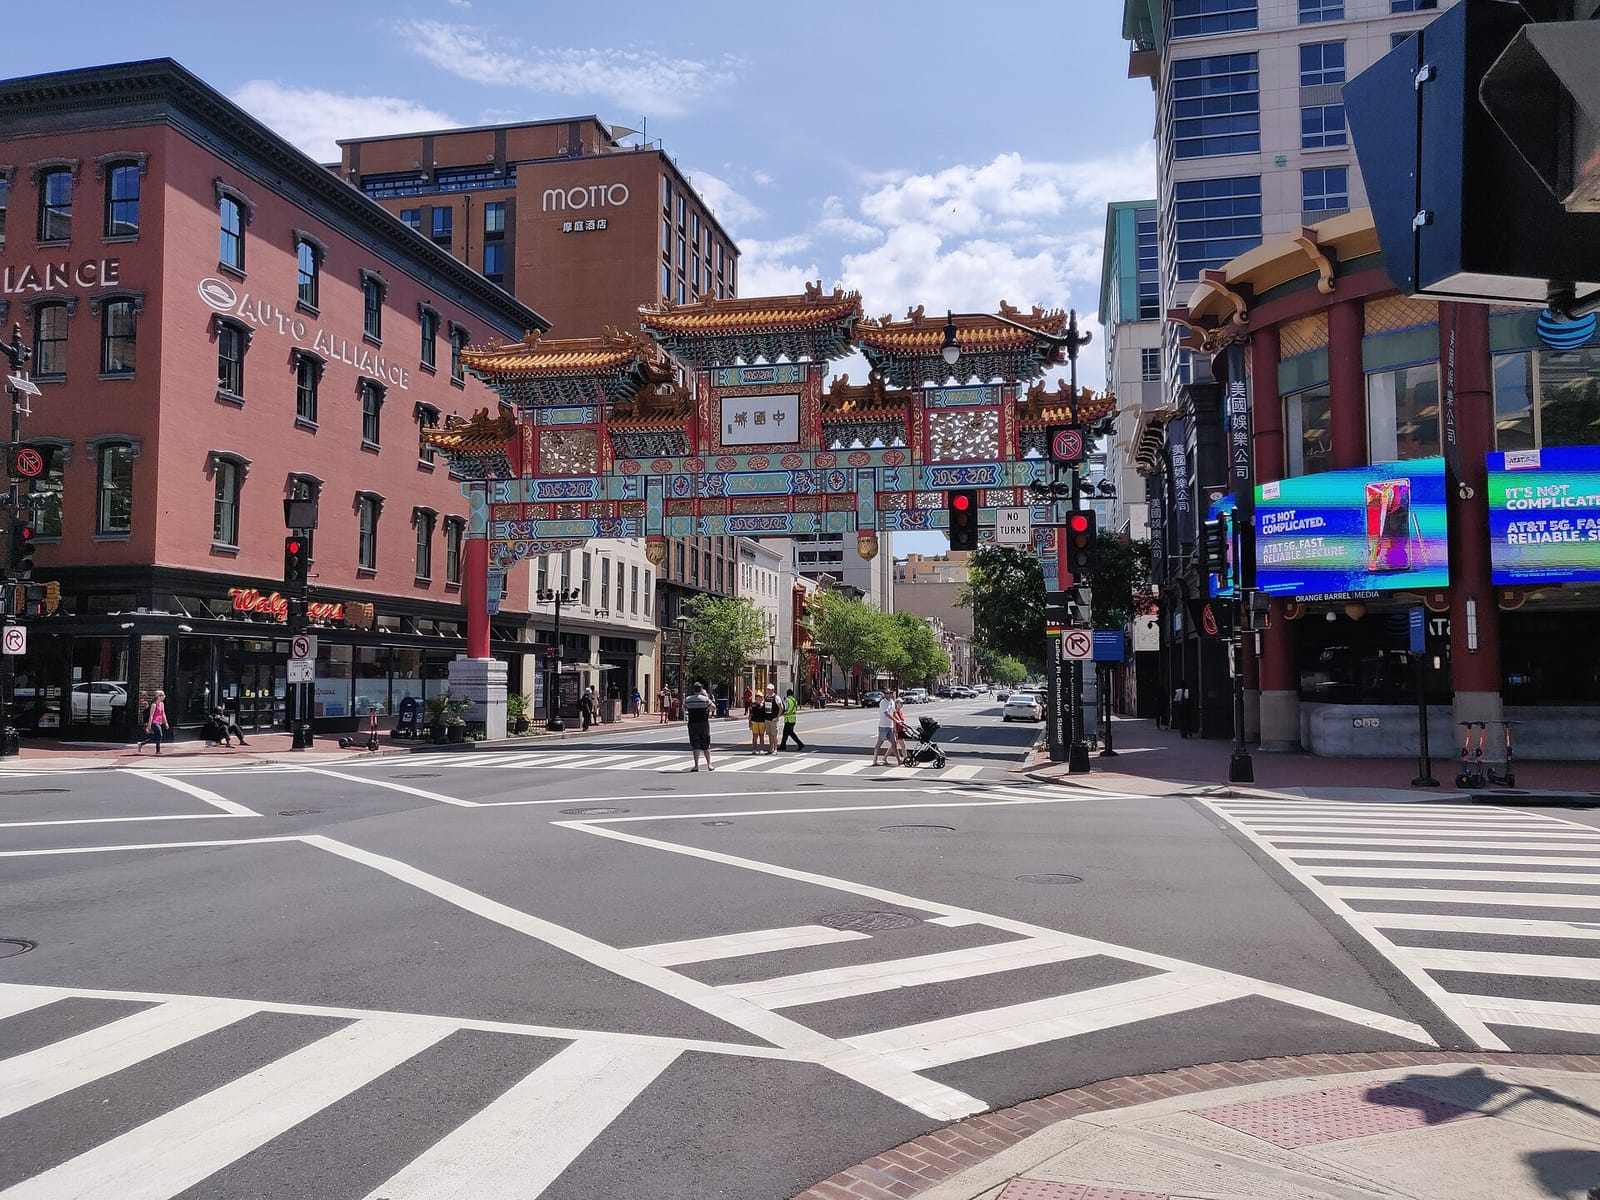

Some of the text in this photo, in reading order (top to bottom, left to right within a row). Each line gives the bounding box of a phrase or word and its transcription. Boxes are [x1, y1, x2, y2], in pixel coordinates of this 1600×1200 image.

[236, 293, 410, 390] AUTO ALLIANCE
[1505, 484, 1570, 499] IT'S NOT
[1007, 512, 1019, 521] NO
[1262, 510, 1296, 525] IT'S NOT
[1000, 526, 1027, 535] TURNS
[1262, 517, 1326, 535] COMPLICATED.
[1507, 521, 1547, 534] AT&T
[1549, 519, 1575, 531] 5G.
[1507, 531, 1585, 545] RELIABLE.
[1263, 542, 1282, 555] AT&T
[1263, 546, 1348, 564] RELIABLE. SECURE.
[1295, 590, 1380, 603] ORANGE BARREL MEDIA
[229, 588, 345, 622] Walgens
